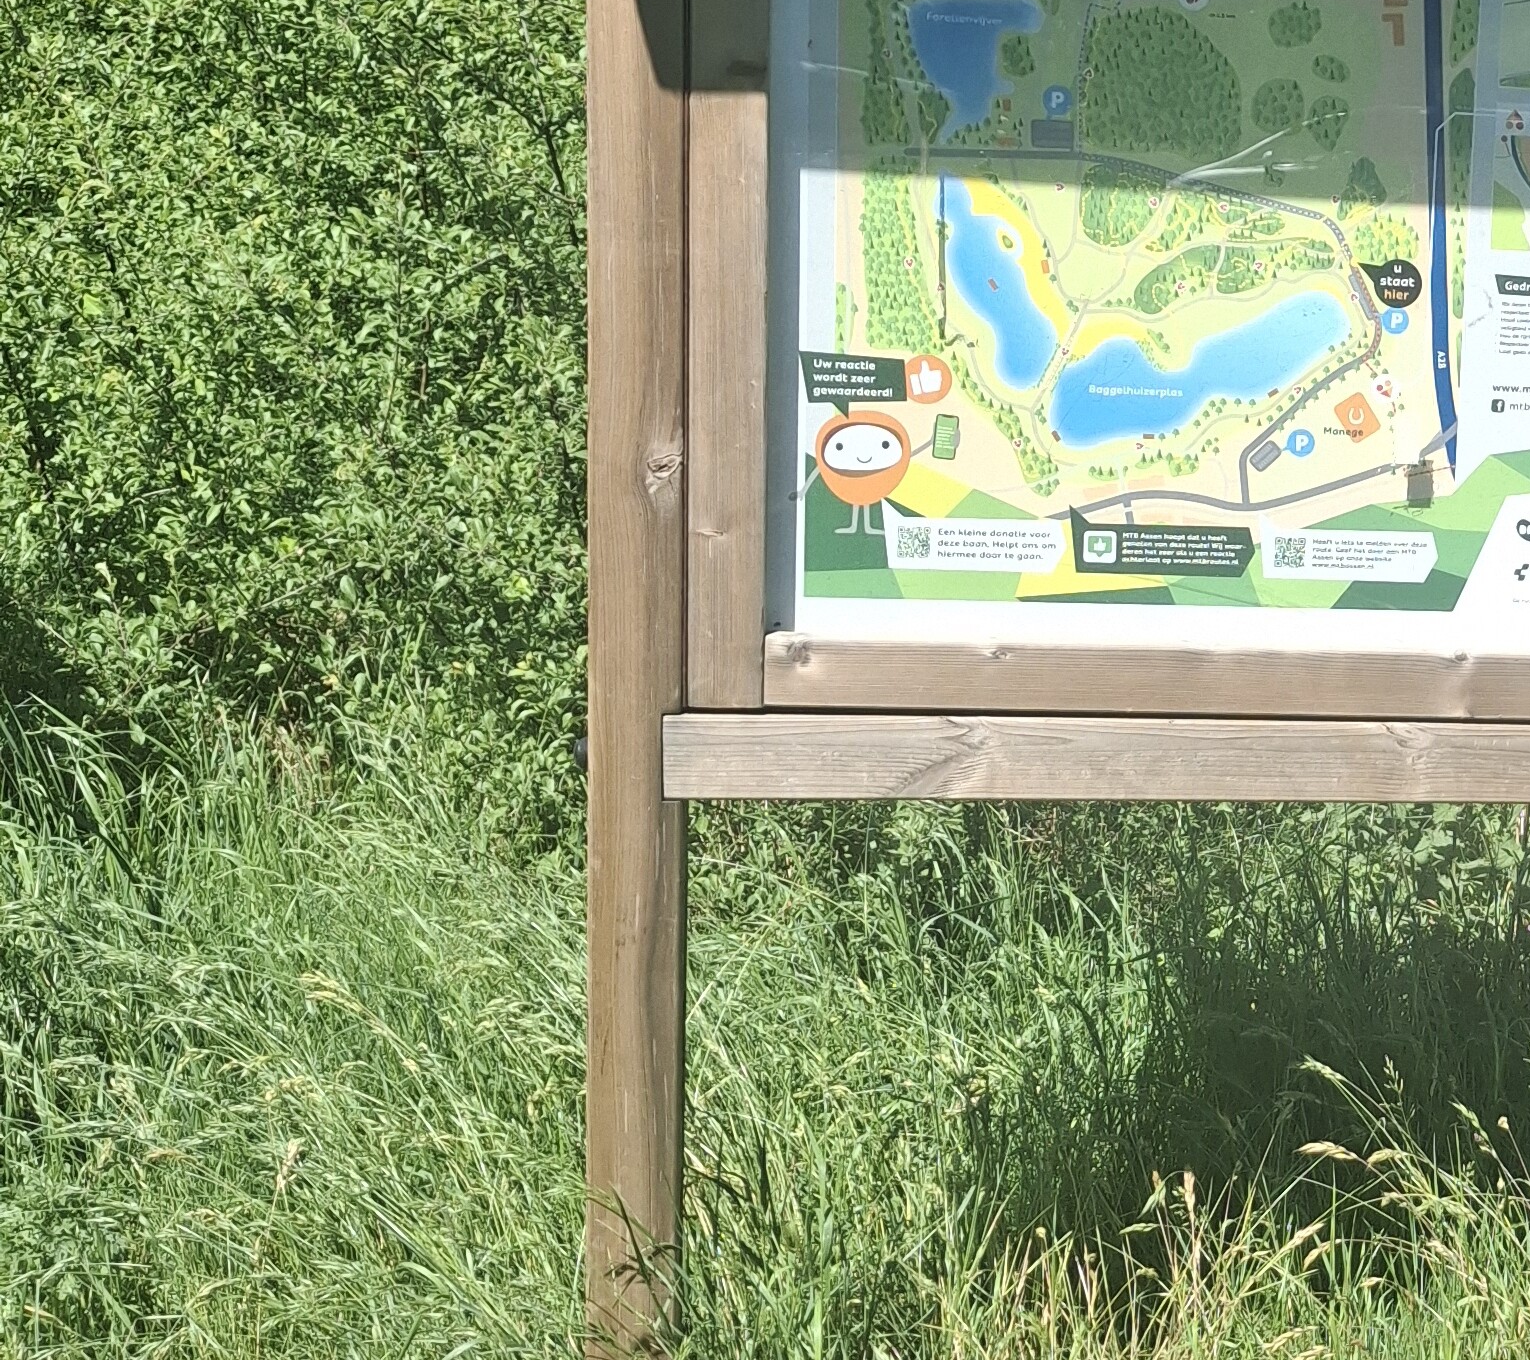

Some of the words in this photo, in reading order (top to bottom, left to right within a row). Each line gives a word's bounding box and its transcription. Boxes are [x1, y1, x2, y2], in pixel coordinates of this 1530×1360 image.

[1050, 91, 1065, 109] P
[1393, 264, 1402, 274] u
[1379, 276, 1416, 288] staat
[1383, 288, 1410, 300] hier
[1390, 312, 1404, 329] P
[813, 358, 833, 369] Uw
[834, 360, 876, 371] reactie
[1436, 350, 1447, 369] A28
[812, 372, 848, 383] wordt
[850, 375, 877, 383] zeer
[812, 386, 893, 397] gewaardeerd!
[1088, 384, 1184, 398] Baggelhuizerplas
[1323, 426, 1364, 437] Manege
[1294, 434, 1309, 452] P
[938, 528, 956, 536] Een
[958, 529, 987, 537] kleine
[990, 530, 1027, 538] donatie
[937, 539, 960, 547] deze
[992, 541, 1019, 550] Helpt
[937, 551, 977, 559] hiermee
[979, 551, 1002, 559] door
